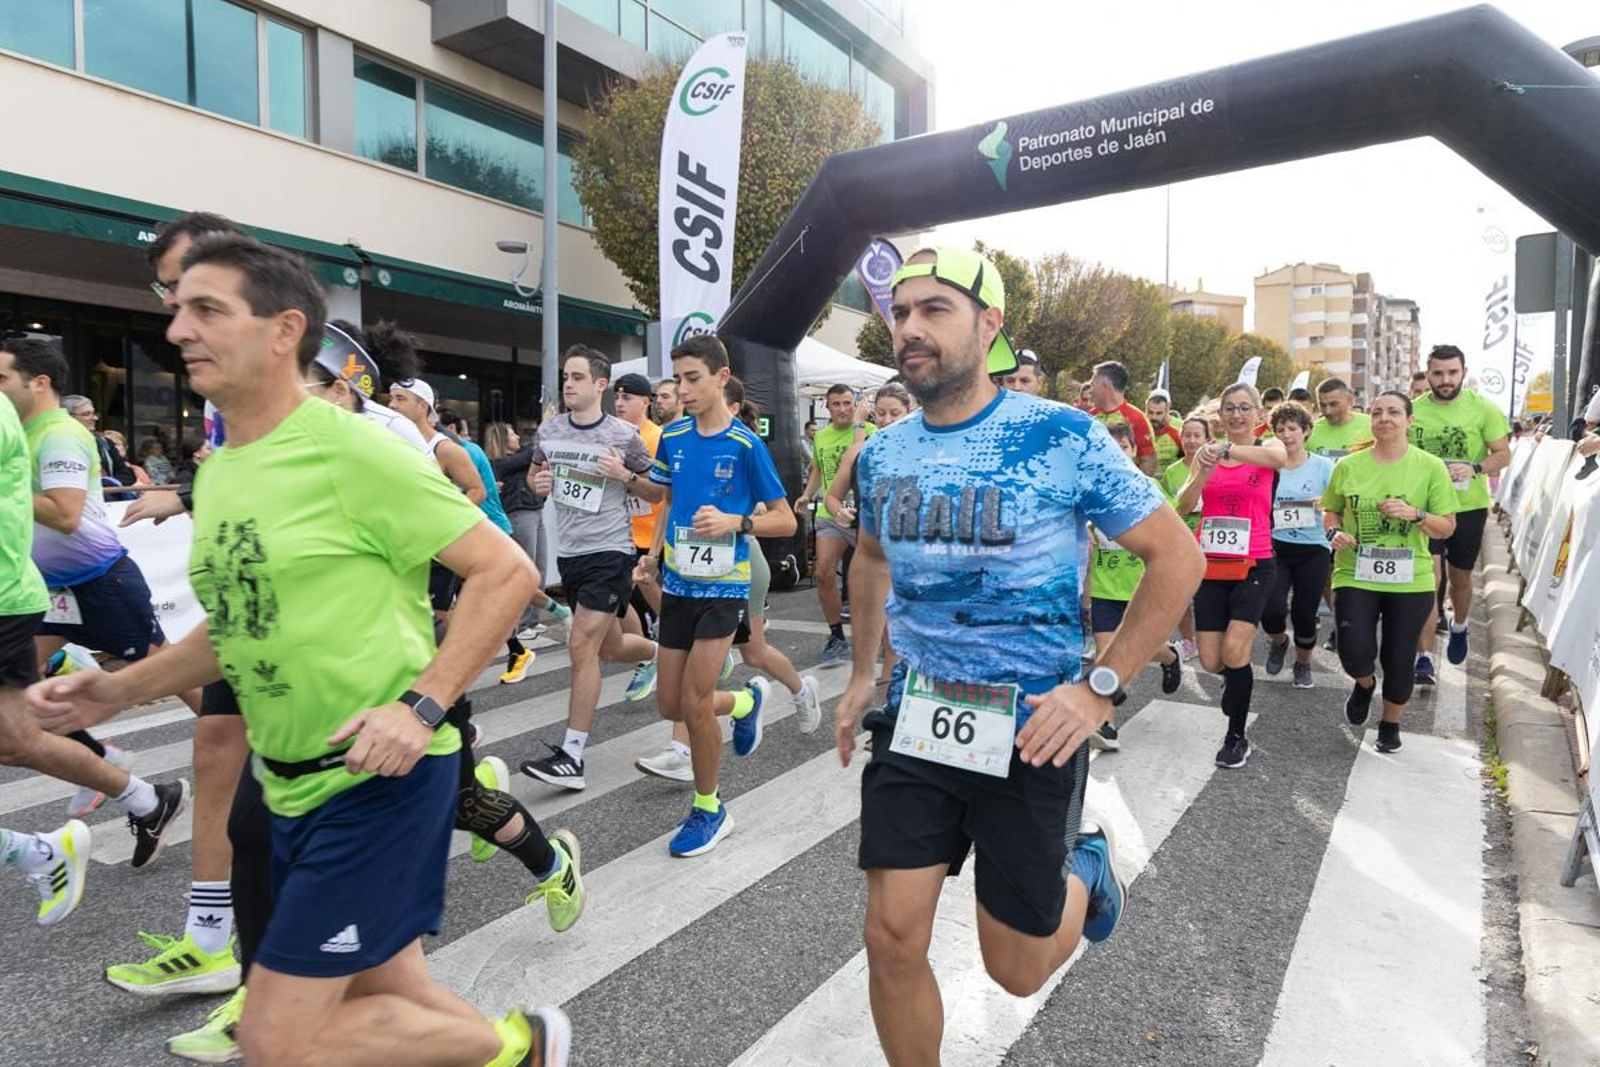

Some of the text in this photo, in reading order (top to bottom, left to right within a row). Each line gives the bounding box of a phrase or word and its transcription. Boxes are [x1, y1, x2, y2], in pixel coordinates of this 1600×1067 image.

[691, 81, 736, 101] CSIF
[1019, 98, 1214, 152] Patronato Municipal de
[1019, 129, 1166, 171] Deportes de Jaén
[672, 150, 726, 283] CSIF
[563, 481, 592, 501] 387
[873, 475, 1014, 545] TRAIL
[1284, 509, 1300, 522] 51
[1208, 530, 1238, 545] 193
[689, 545, 713, 565] 74
[1373, 560, 1396, 575] 68
[931, 706, 977, 745] 66
